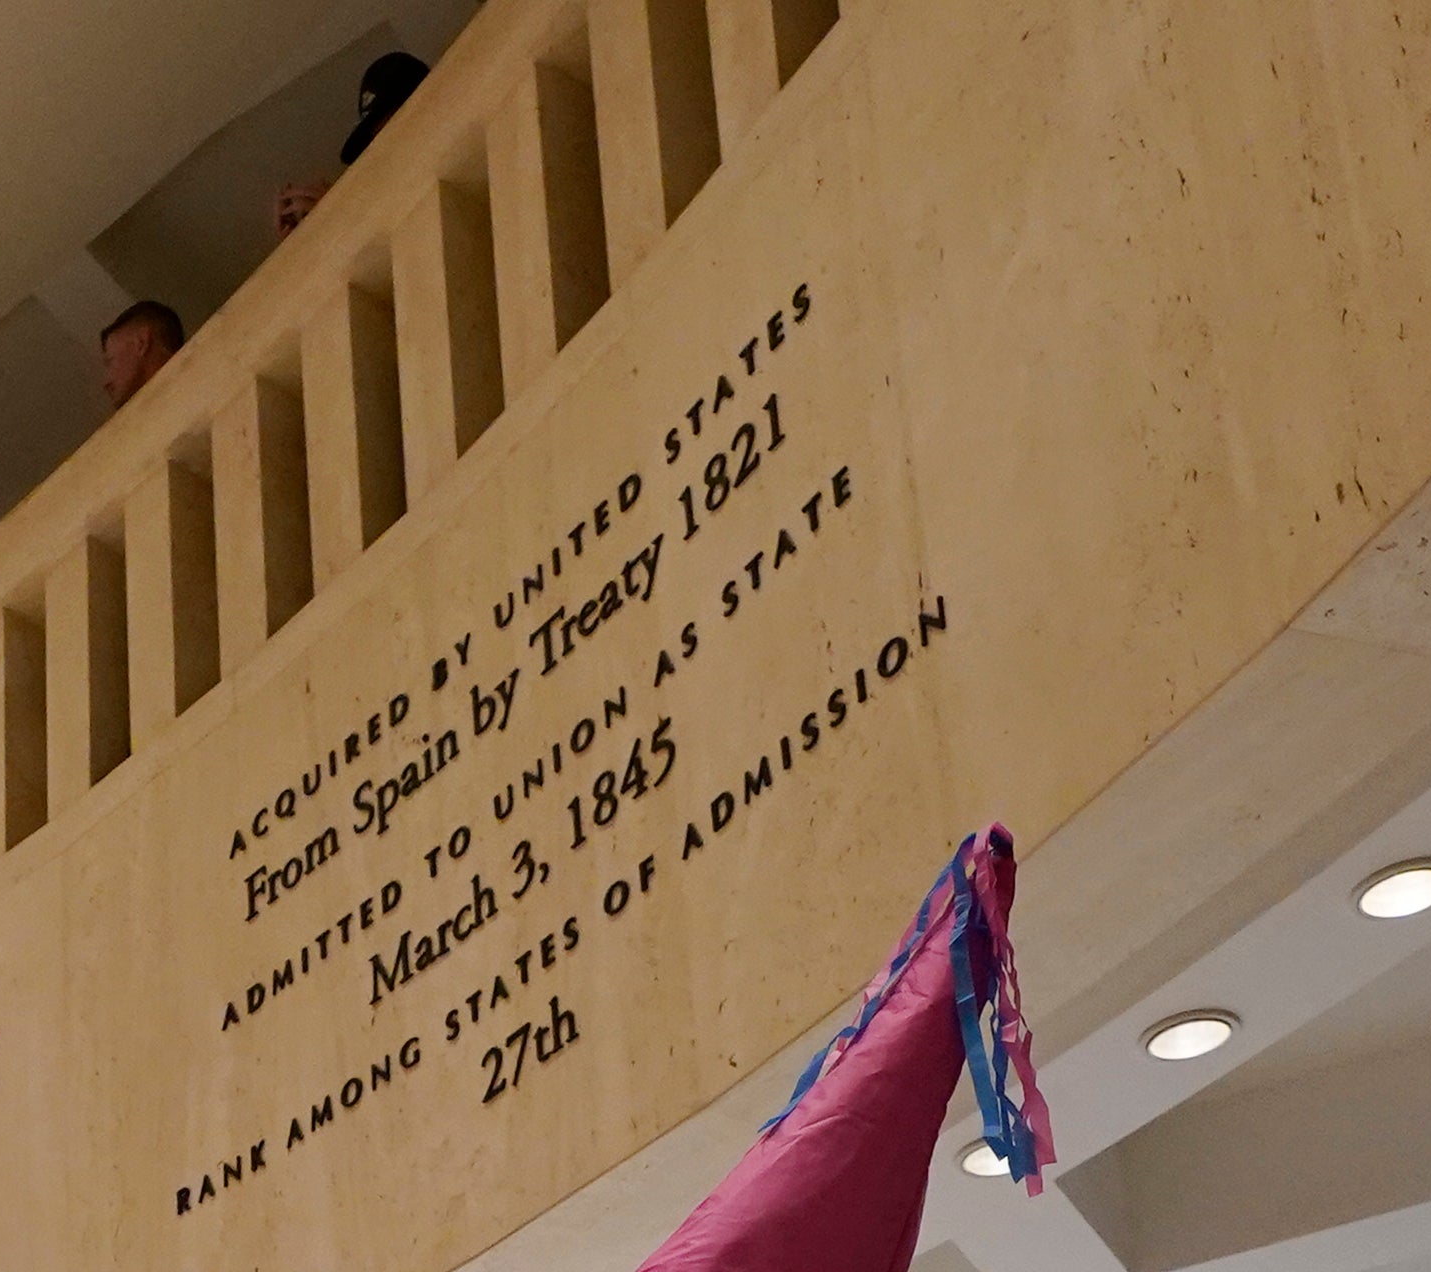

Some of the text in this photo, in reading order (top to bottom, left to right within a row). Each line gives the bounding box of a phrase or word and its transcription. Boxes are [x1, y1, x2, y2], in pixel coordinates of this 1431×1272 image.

[222, 467, 852, 1030] ADMITTED TO UNION AS STATE
[229, 282, 811, 859] ACQUIRED BY UNITED STATES
[244, 393, 787, 922] From Spain by Treaty 1821
[176, 597, 948, 1216] RANK AMONG STATES OF ADMISSION
[369, 717, 677, 1004] March 3, 1845
[479, 1000, 580, 1104] 27th
